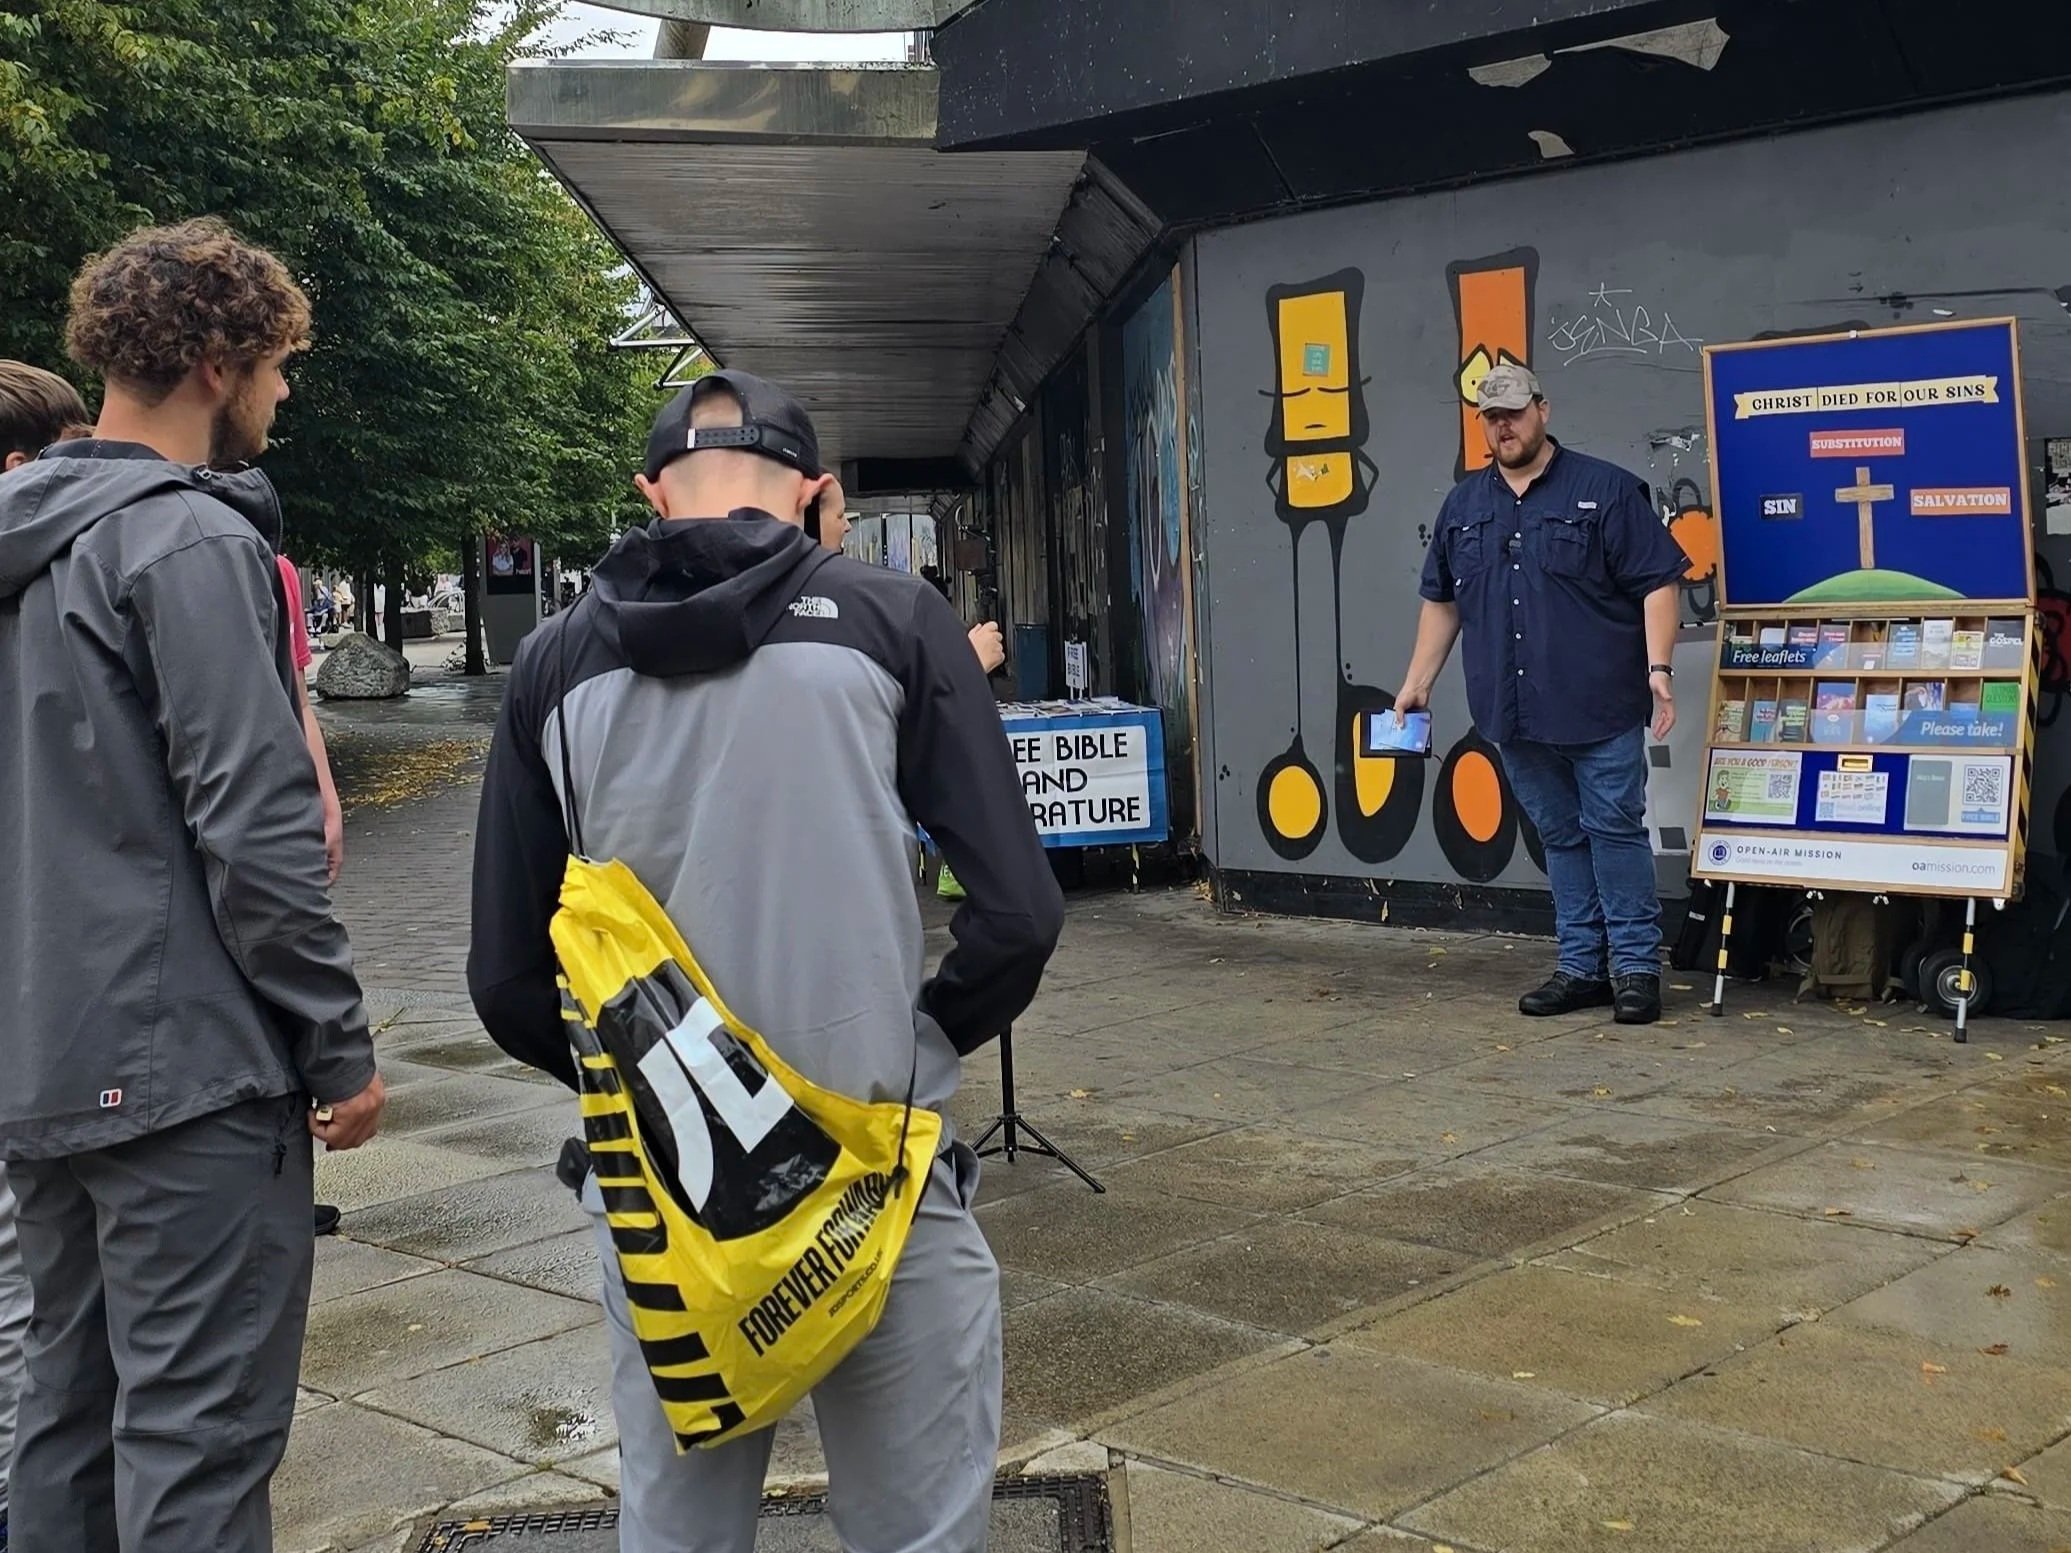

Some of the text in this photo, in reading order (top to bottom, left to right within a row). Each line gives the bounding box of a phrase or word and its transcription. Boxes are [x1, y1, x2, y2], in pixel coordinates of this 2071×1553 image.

[1752, 383, 1985, 411] CHRIST DIED FOR OUR SINS
[1811, 435, 1902, 450] SUBSTITUTION
[1763, 498, 1798, 516] SIN
[1913, 493, 2008, 508] SALVATION
[1733, 649, 1807, 664] Free leaflets
[1920, 720, 2004, 736] Please take!
[1013, 732, 1129, 763] EE BIBLE
[1022, 768, 1088, 795] AND
[1030, 796, 1141, 827] RATURE
[1737, 845, 1790, 857] OPEN-AIR
[1794, 849, 1842, 860] MISSION
[1911, 860, 1996, 875] oamission.com
[738, 1245, 838, 1357] FOREVER
